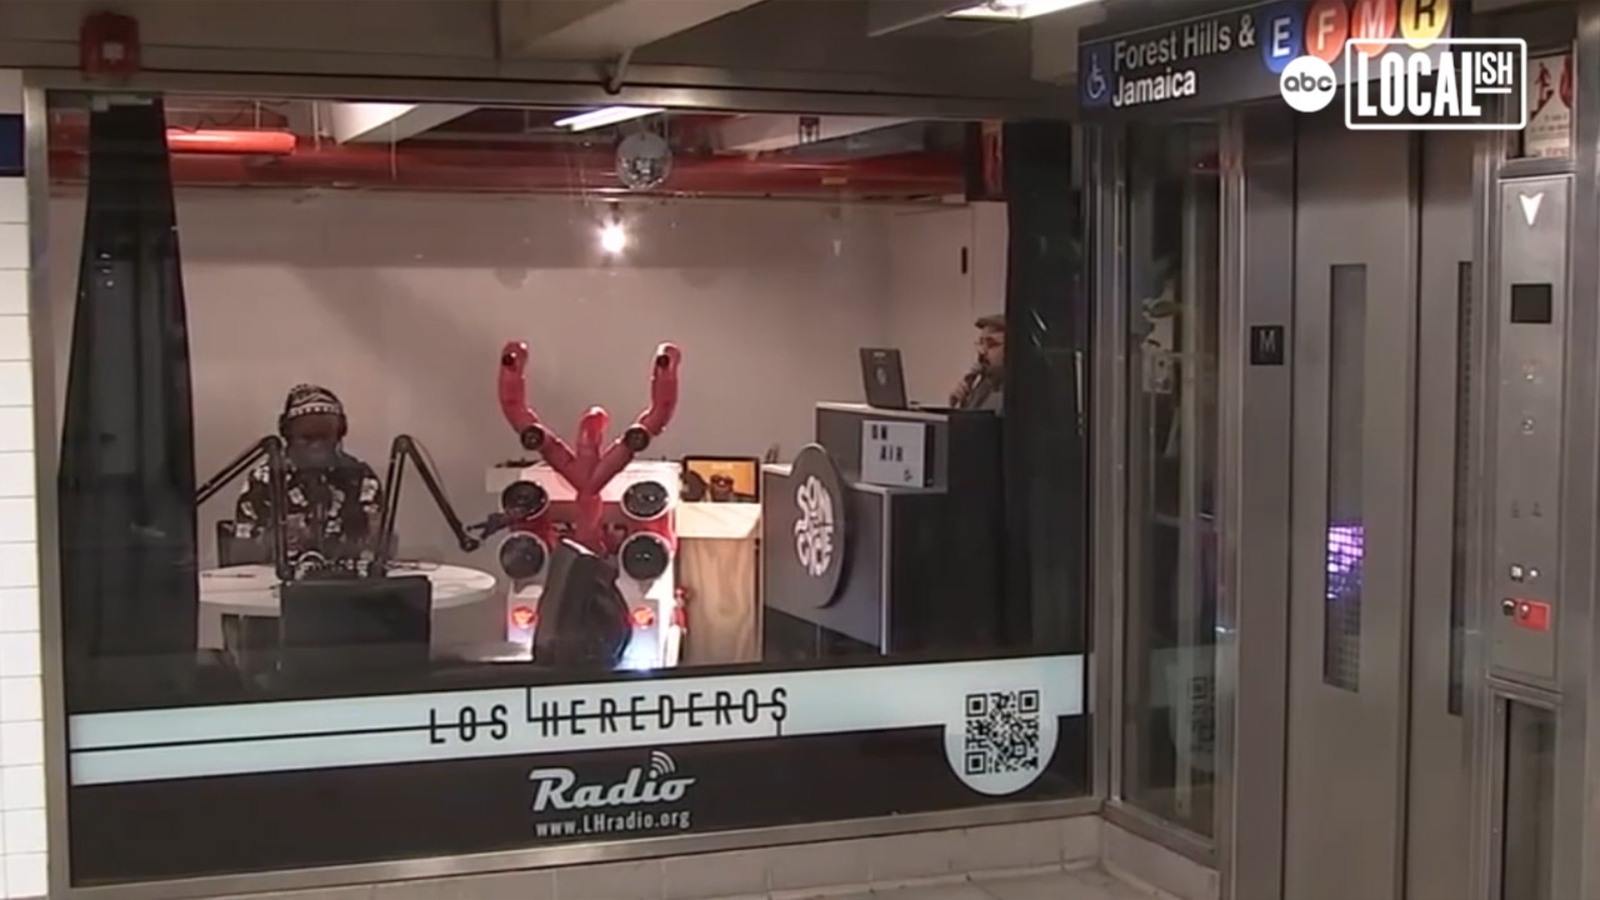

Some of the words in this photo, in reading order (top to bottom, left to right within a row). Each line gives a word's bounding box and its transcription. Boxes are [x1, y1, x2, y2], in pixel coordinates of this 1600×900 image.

[1113, 30, 1178, 73] Forest
[1183, 20, 1231, 59] Hills
[1238, 14, 1256, 48] &
[1272, 17, 1291, 58] E
[1316, 8, 1337, 51] F
[1359, 0, 1387, 40] M
[1113, 66, 1197, 107] Jamaica
[881, 445, 903, 462] AIR
[429, 704, 508, 745] LOS
[535, 686, 788, 738] HEREDEROS
[528, 766, 697, 812] Radio
[535, 810, 692, 838] www.LHradio.org
